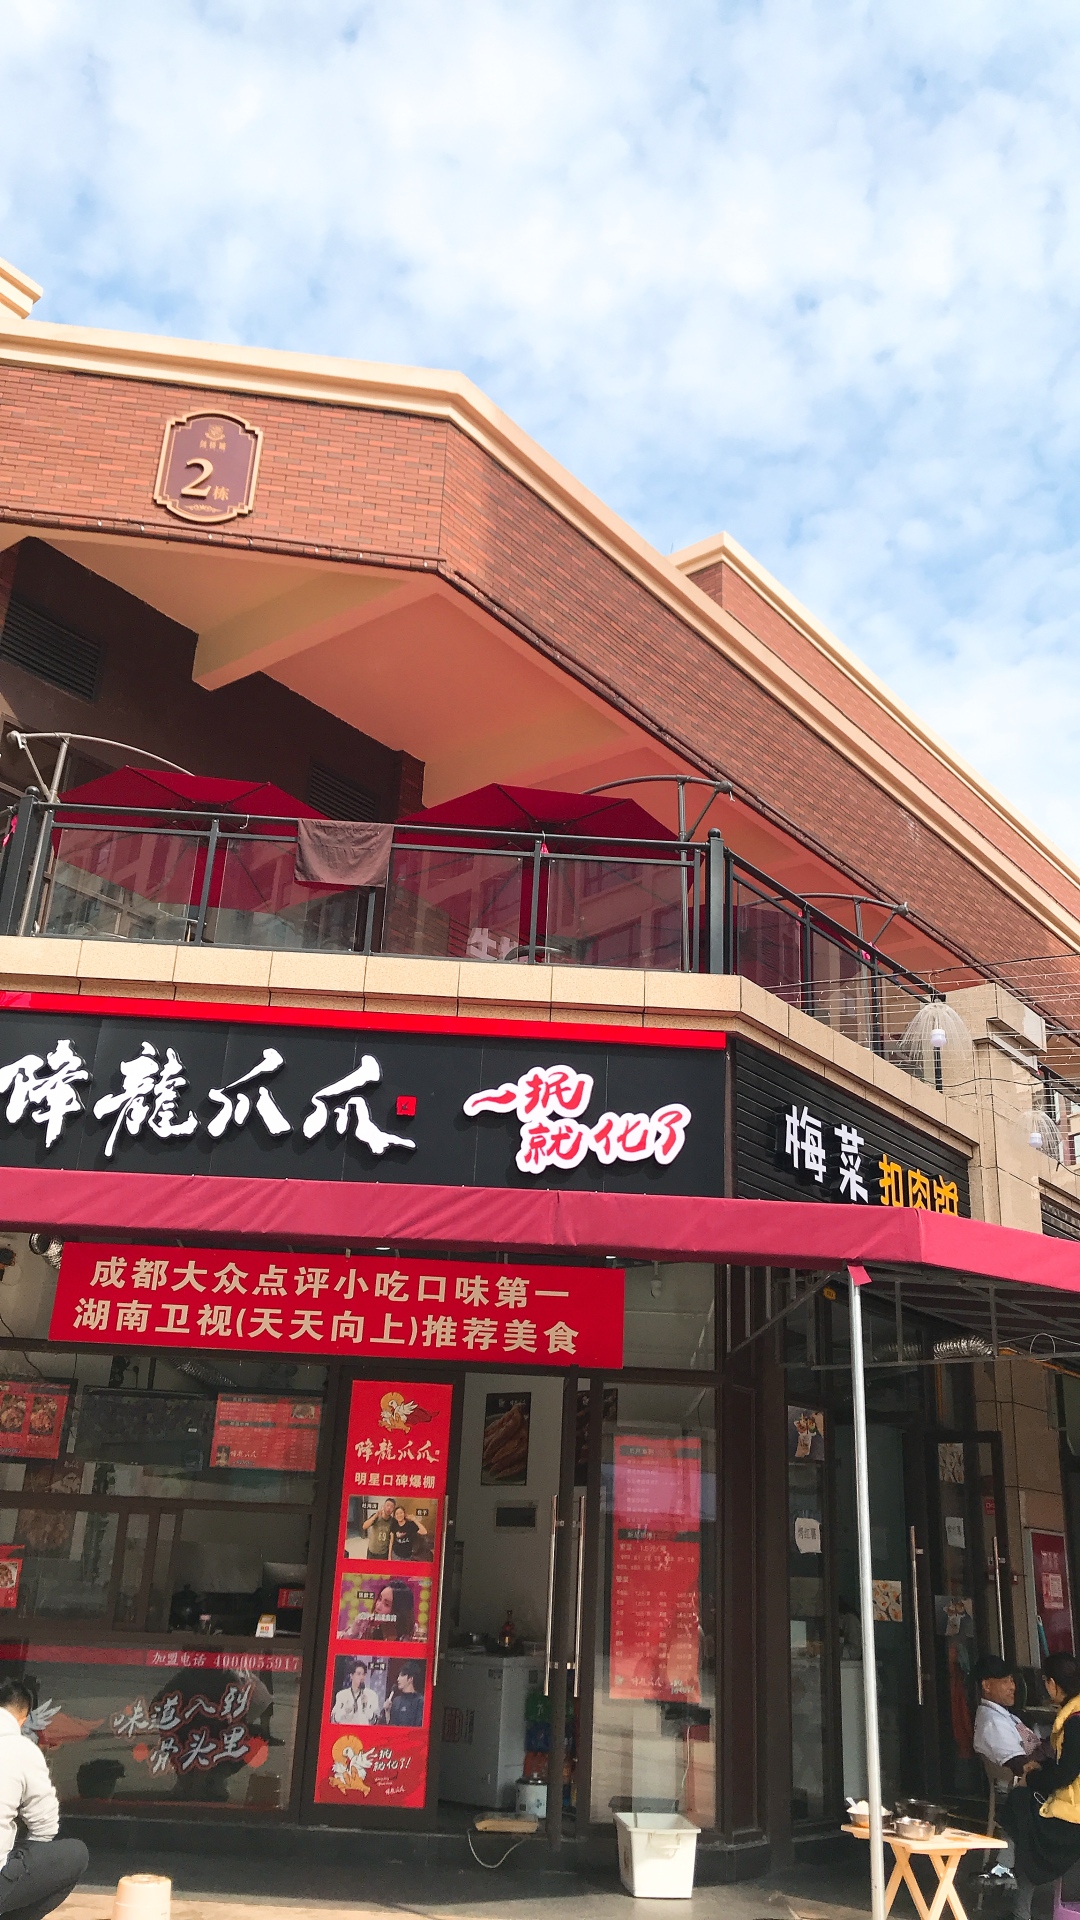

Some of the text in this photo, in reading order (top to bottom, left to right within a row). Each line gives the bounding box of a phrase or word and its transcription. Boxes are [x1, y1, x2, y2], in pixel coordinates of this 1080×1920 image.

[468, 1068, 589, 1119] 一抿
[520, 1108, 688, 1169] 就化了
[90, 1256, 570, 1309] 成都大众点评小吃口味第一
[73, 1297, 579, 1355] 湖南卫视(天天向上)推荐美食
[354, 1472, 436, 1489] 明星口碑爆棚
[152, 1651, 206, 1667] 加盟电话
[150, 1725, 249, 1774] 骨头里
